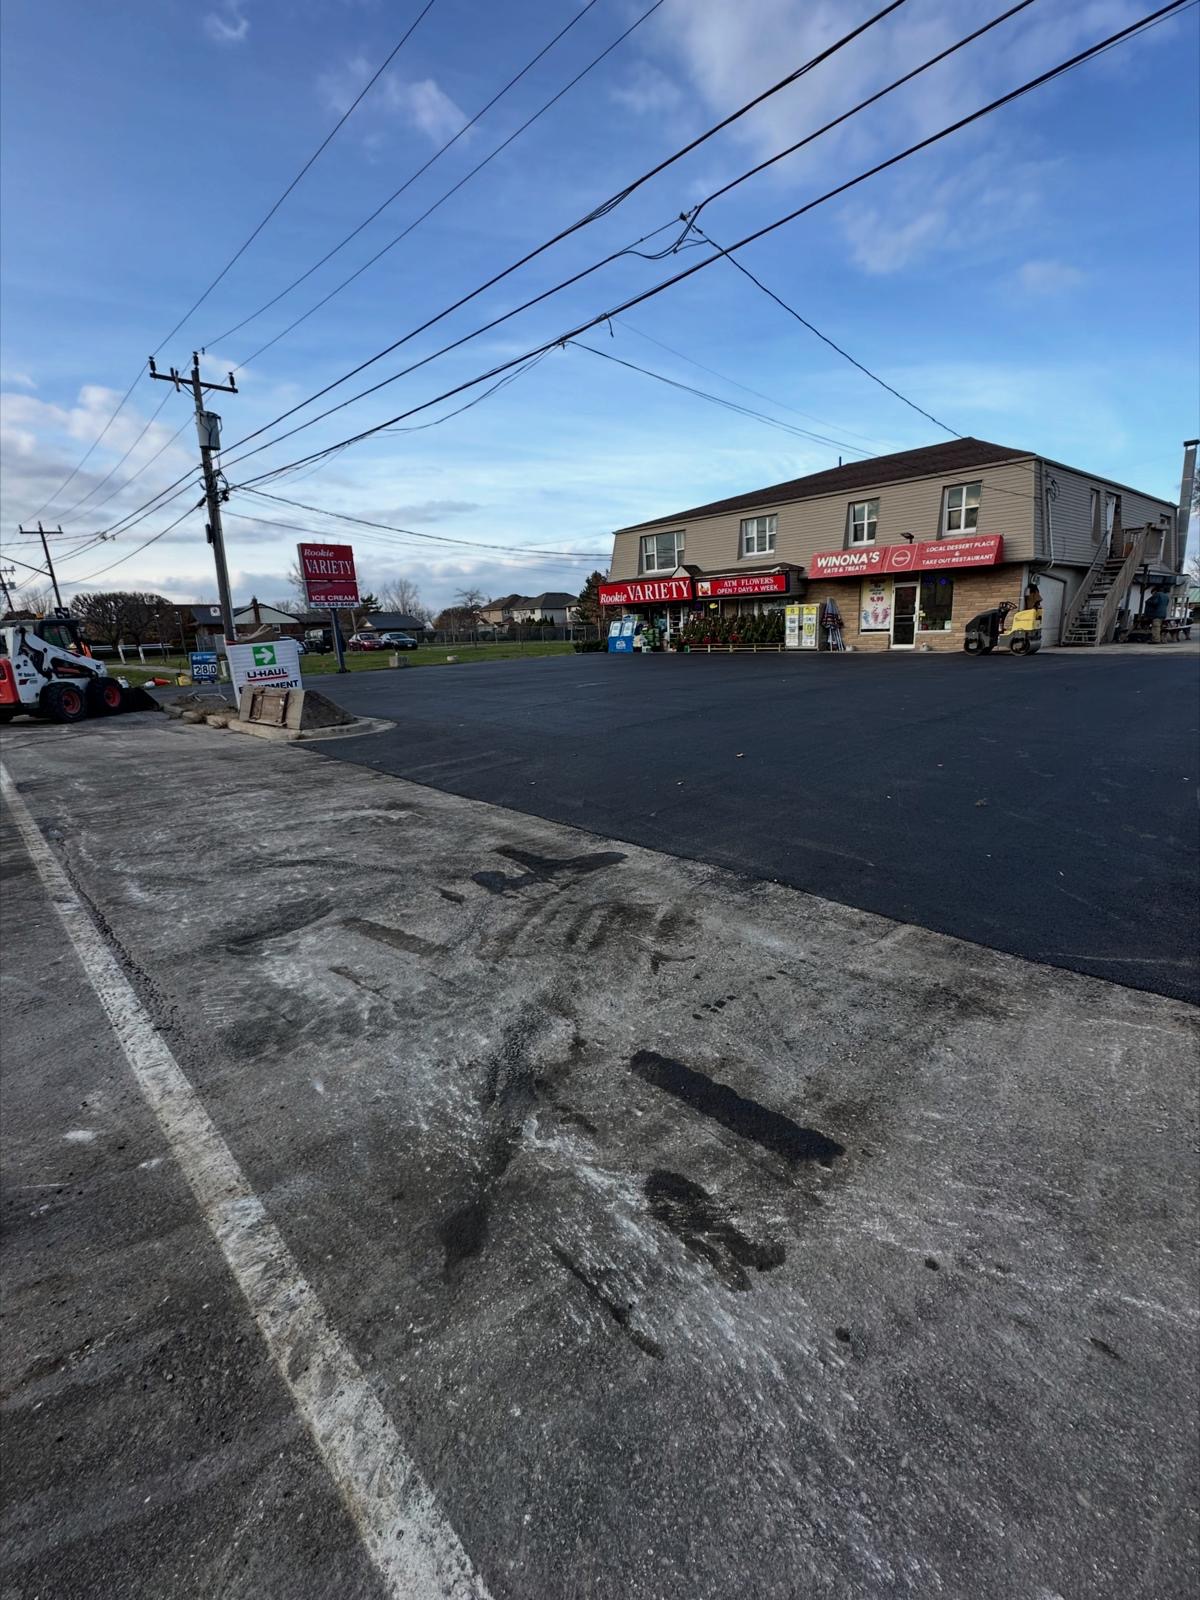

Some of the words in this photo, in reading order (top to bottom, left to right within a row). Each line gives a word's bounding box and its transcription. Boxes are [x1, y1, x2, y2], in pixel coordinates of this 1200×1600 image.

[946, 542, 973, 551] DESSERT
[304, 548, 334, 557] Rookie
[816, 551, 880, 567] WINONA'S
[952, 554, 993, 563] RESTAURANT
[305, 560, 352, 575] VARIETY
[844, 564, 867, 572] TREATS
[724, 579, 737, 588] ATM
[741, 576, 774, 586] FLOWERS
[600, 592, 627, 604] Rookie
[626, 580, 690, 600] VARIETY
[194, 665, 216, 674] 280
[248, 668, 288, 678] U-HAUL
